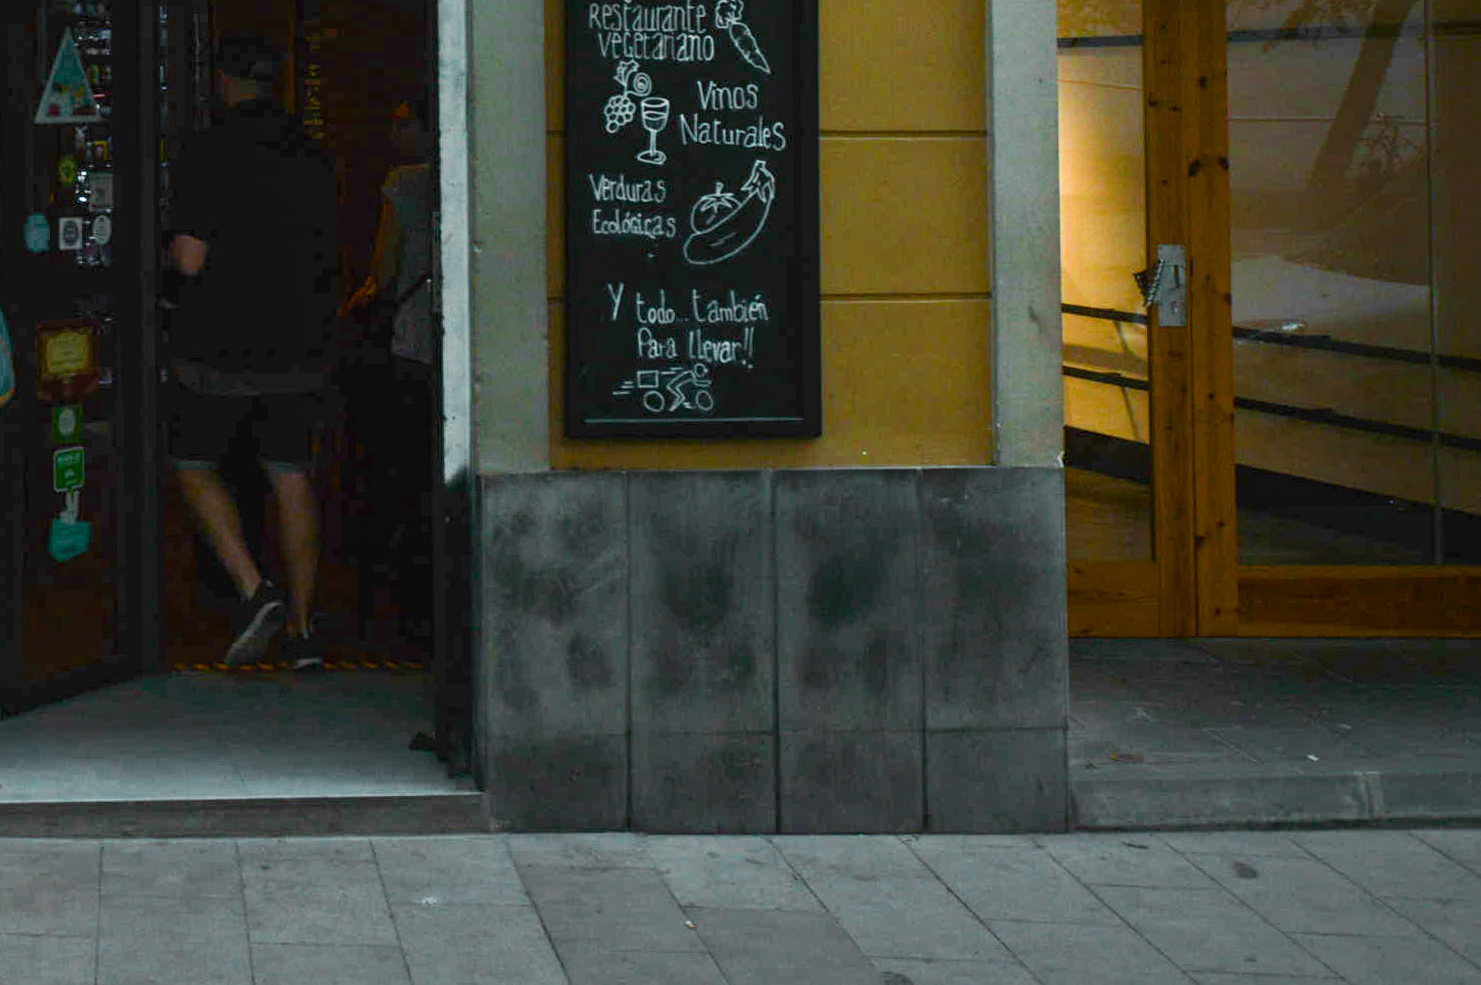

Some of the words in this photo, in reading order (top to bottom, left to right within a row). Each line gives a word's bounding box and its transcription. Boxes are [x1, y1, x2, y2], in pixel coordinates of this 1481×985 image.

[697, 80, 759, 110] Vinos
[680, 113, 786, 151] Naturales
[589, 173, 666, 203] Verduras
